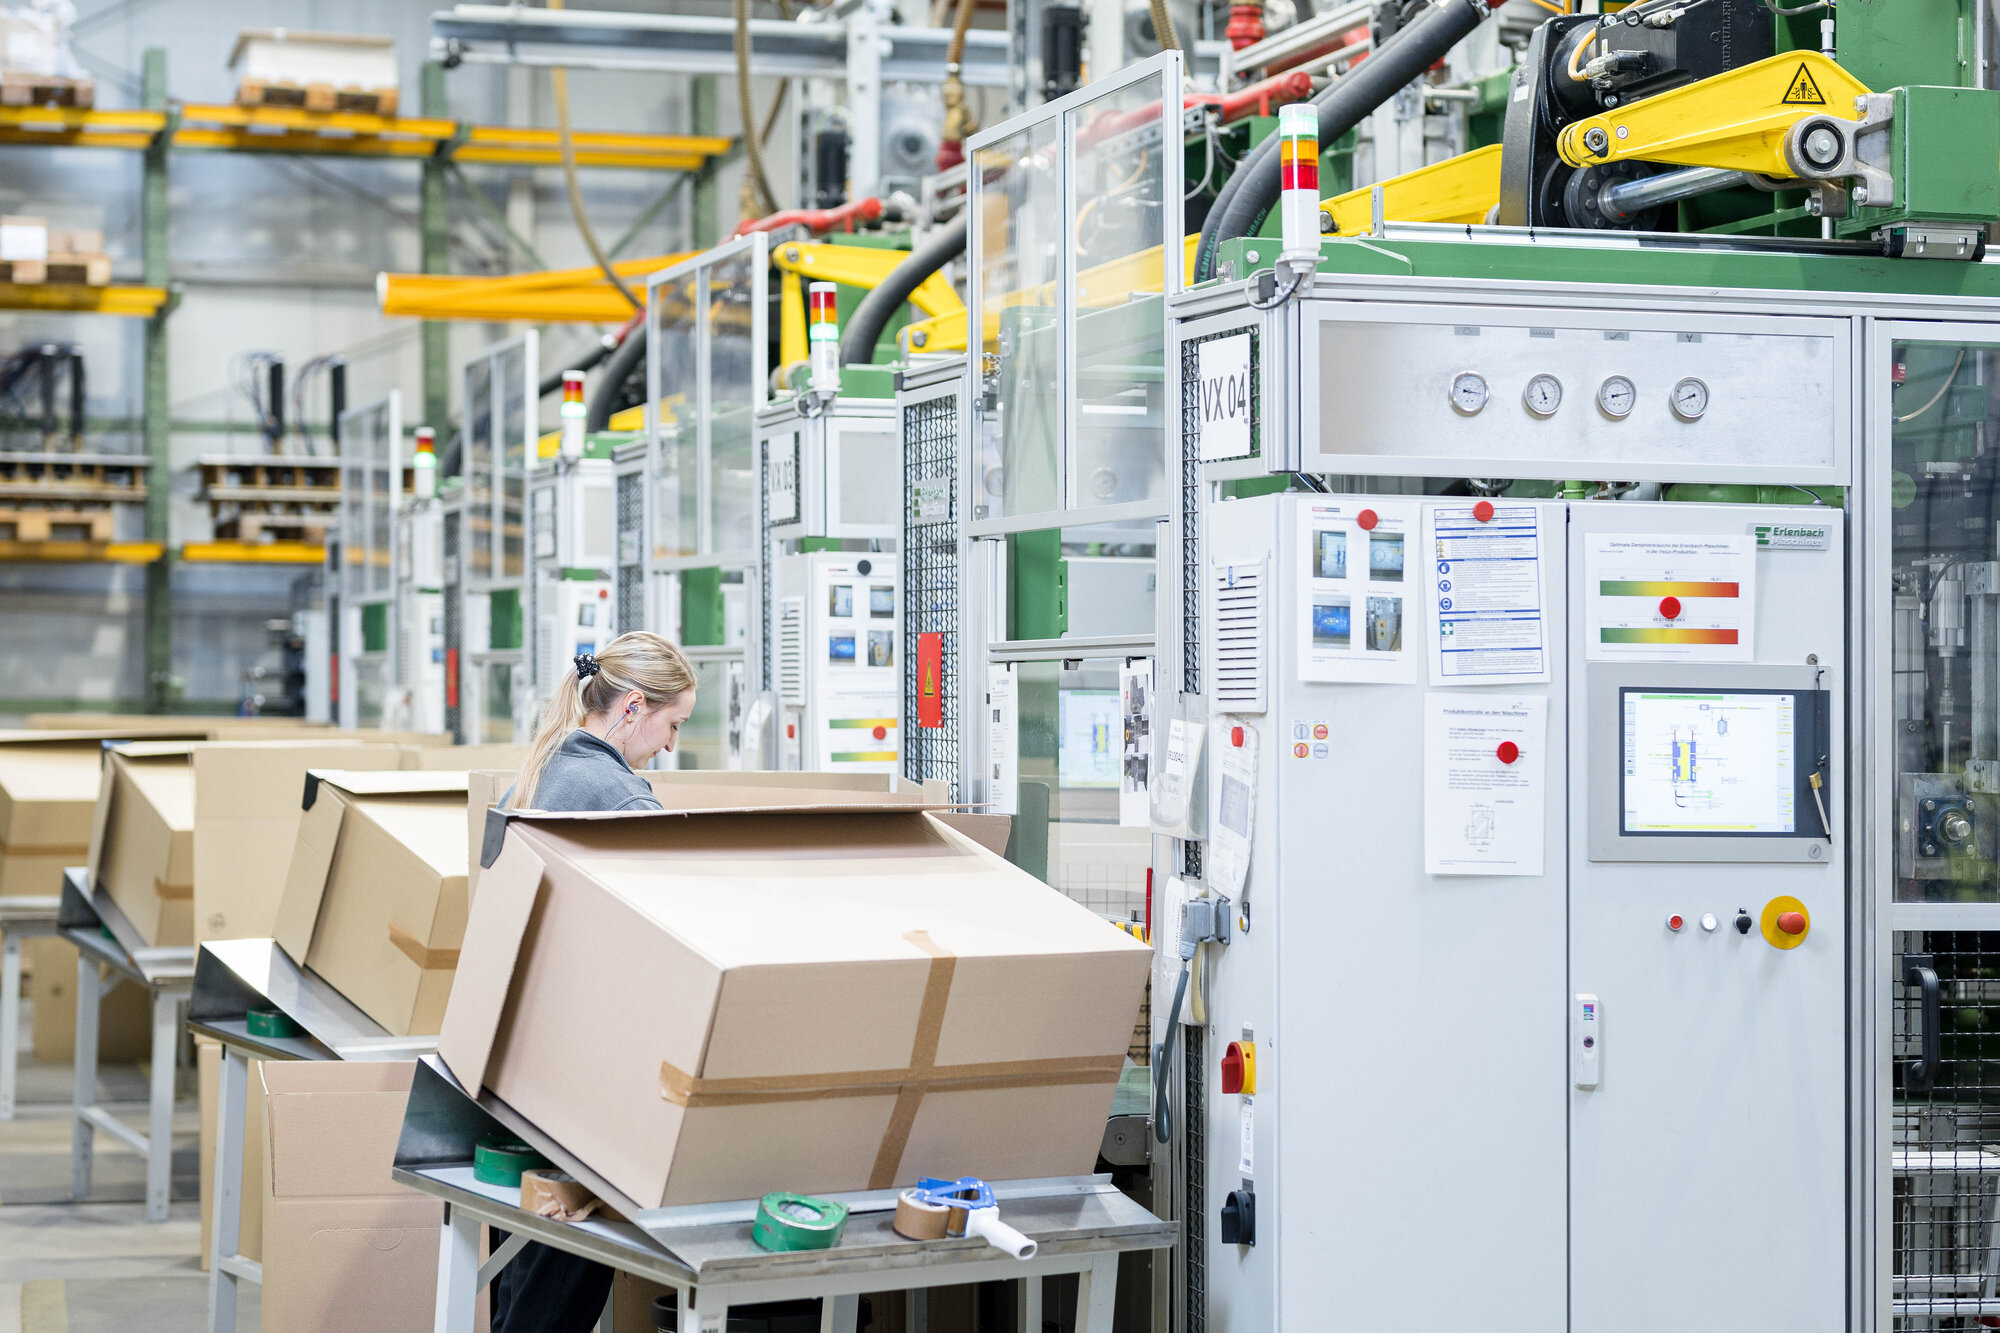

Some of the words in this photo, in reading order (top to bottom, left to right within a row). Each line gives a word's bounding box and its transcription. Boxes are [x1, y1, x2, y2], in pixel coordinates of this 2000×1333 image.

[1246, 207, 1268, 237] NBACH
[1202, 376, 1224, 422] VX
[1228, 372, 1246, 418] 04
[1773, 527, 1824, 537] Erlenbach
